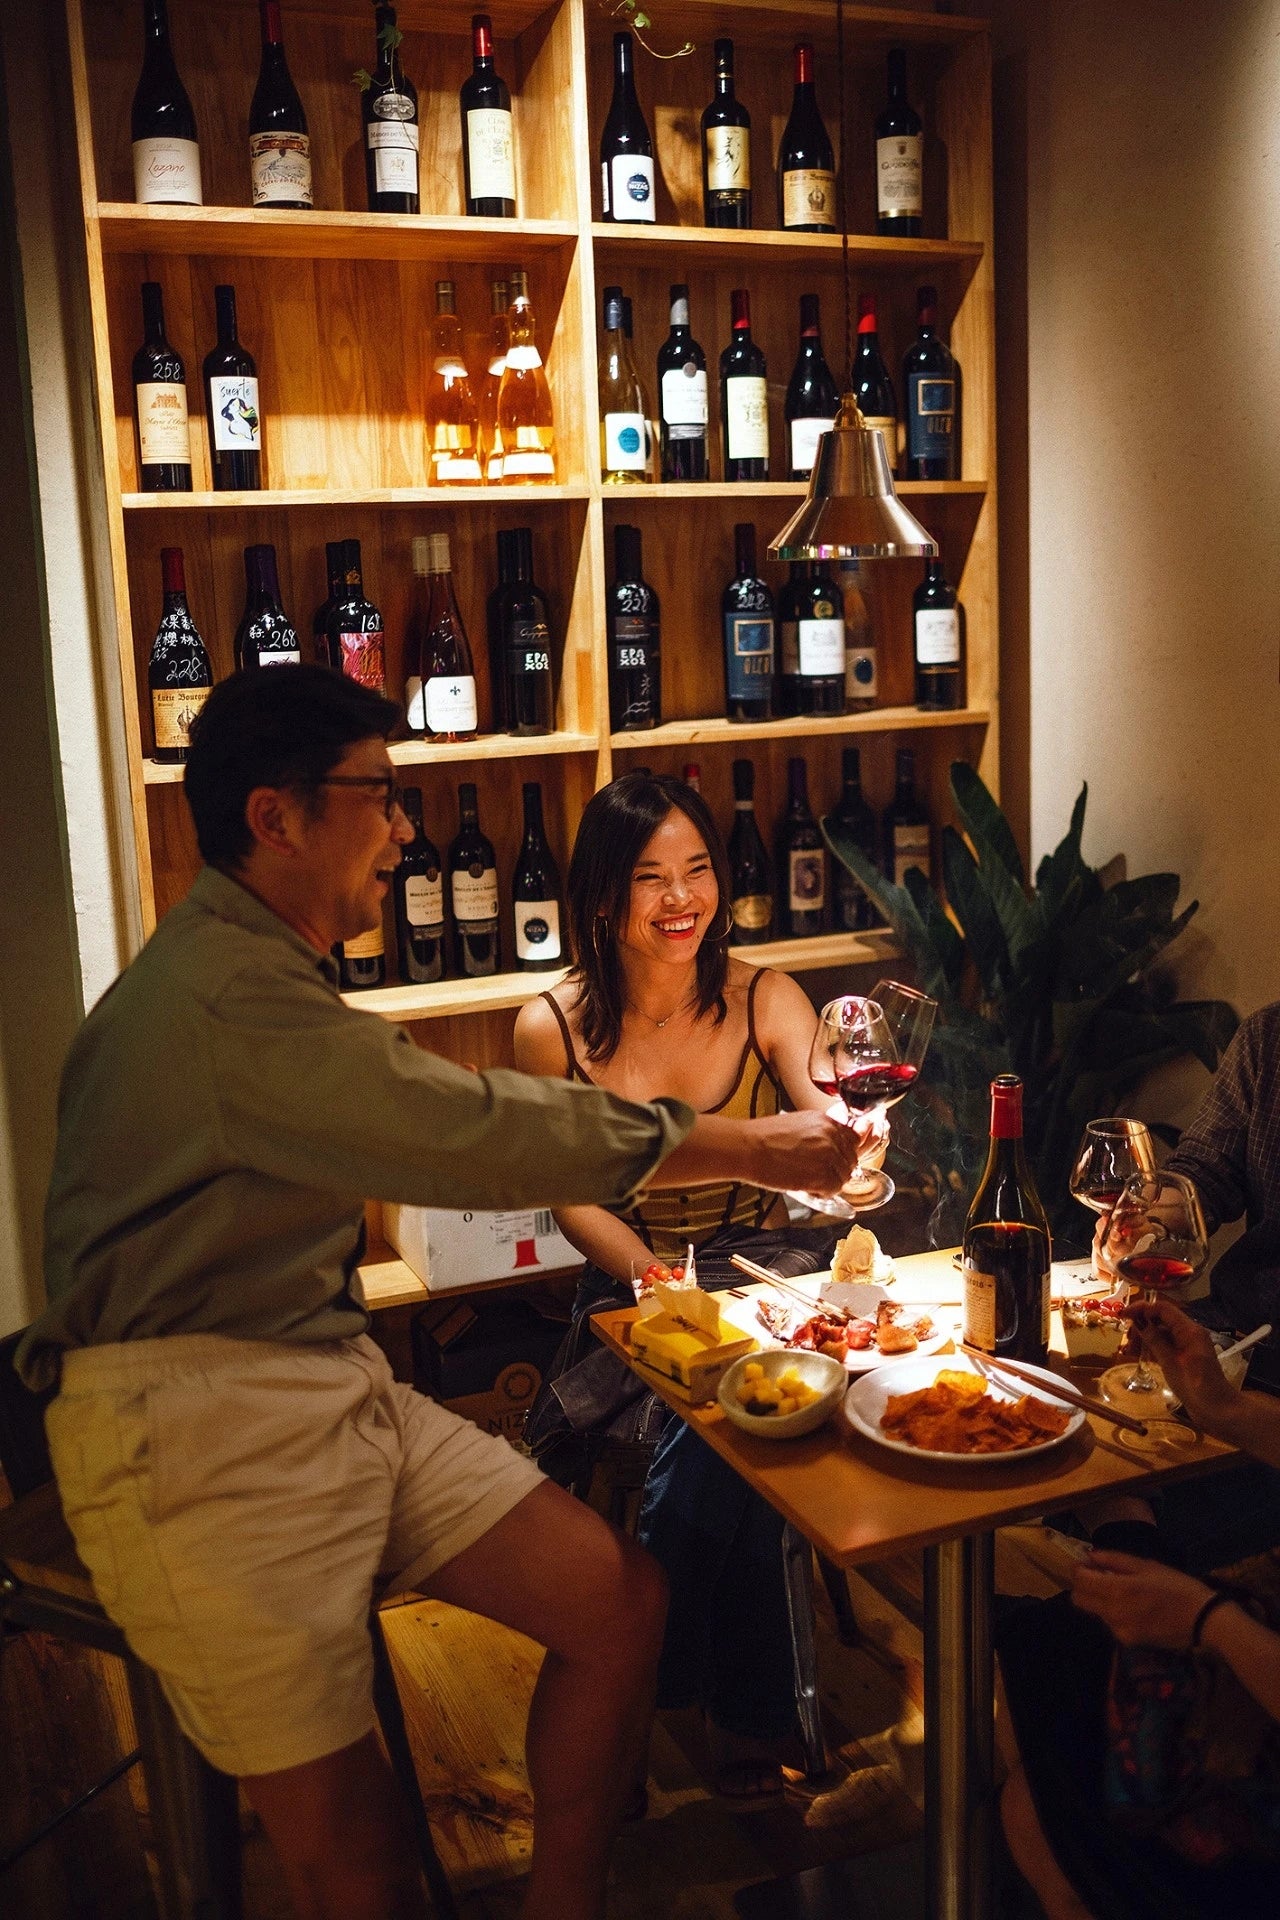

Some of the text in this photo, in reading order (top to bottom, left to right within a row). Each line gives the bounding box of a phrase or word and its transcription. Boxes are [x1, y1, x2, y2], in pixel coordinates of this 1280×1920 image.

[220, 378, 250, 399] suerte
[269, 629, 297, 649] 268
[166, 657, 203, 682] 228
